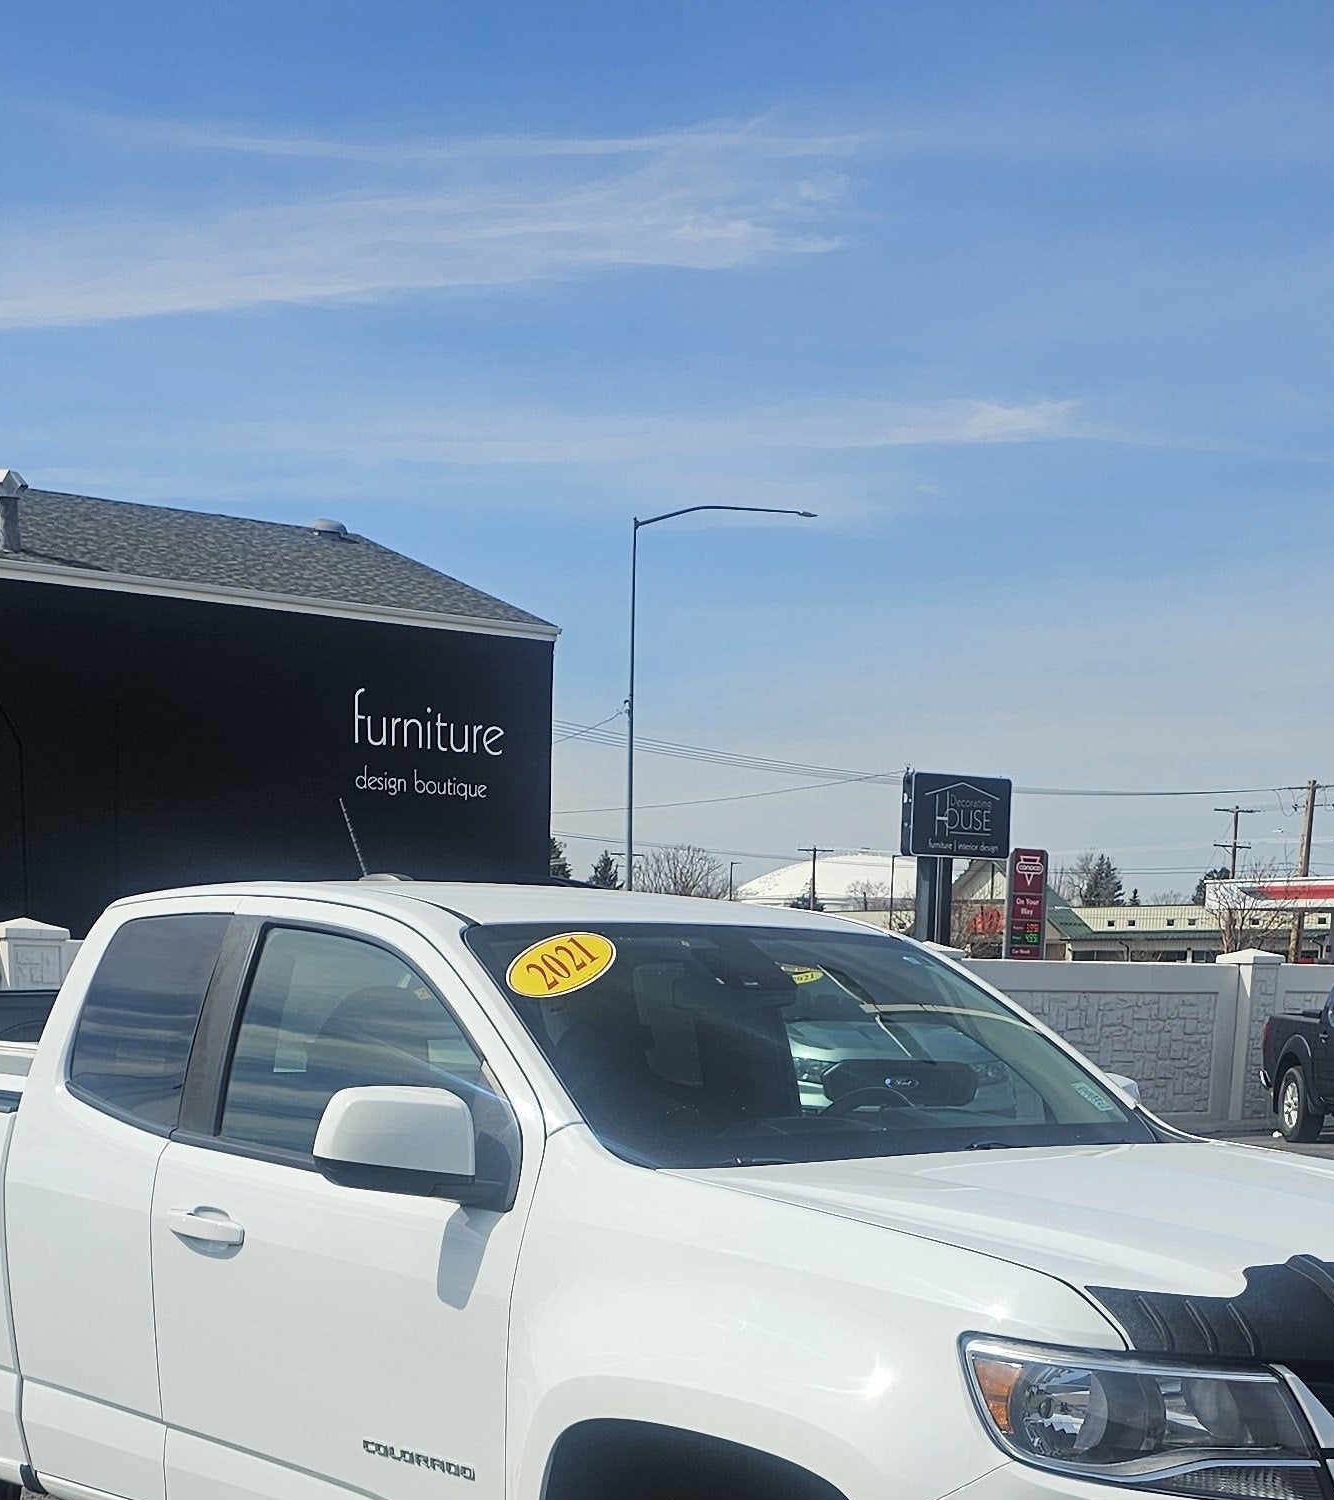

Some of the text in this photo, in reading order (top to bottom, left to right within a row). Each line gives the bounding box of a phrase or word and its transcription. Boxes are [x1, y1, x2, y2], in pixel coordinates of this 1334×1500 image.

[355, 688, 504, 755] furniture
[355, 764, 487, 800] design boutique
[935, 791, 991, 836] HOUSE
[526, 937, 599, 990] 2021
[362, 1439, 476, 1482] COLORADO
